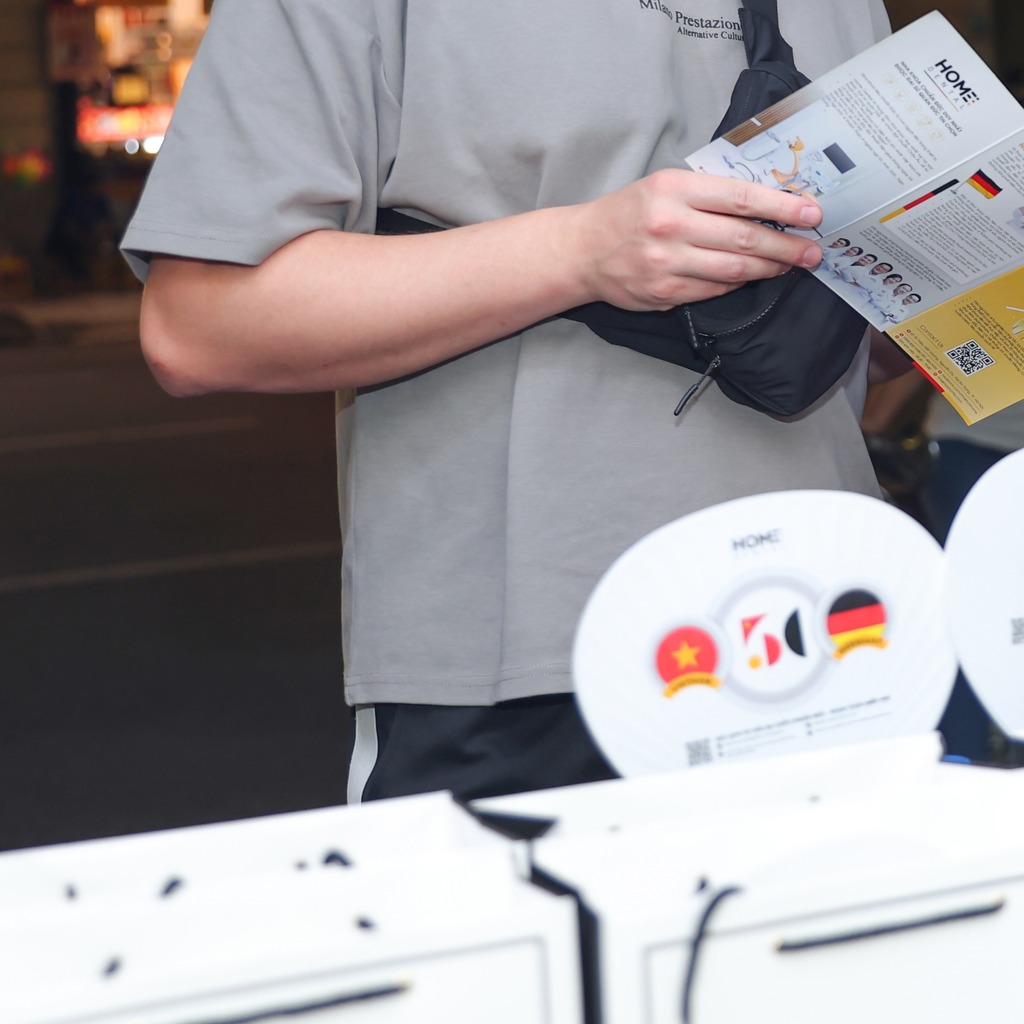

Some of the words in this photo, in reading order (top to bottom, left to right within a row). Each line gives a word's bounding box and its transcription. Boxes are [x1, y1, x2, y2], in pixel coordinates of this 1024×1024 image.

[675, 11, 744, 31] Prestazion
[677, 26, 719, 39] Alternative
[927, 66, 965, 109] DENTAL
[934, 59, 979, 105] HOME
[733, 528, 782, 551] HOME
